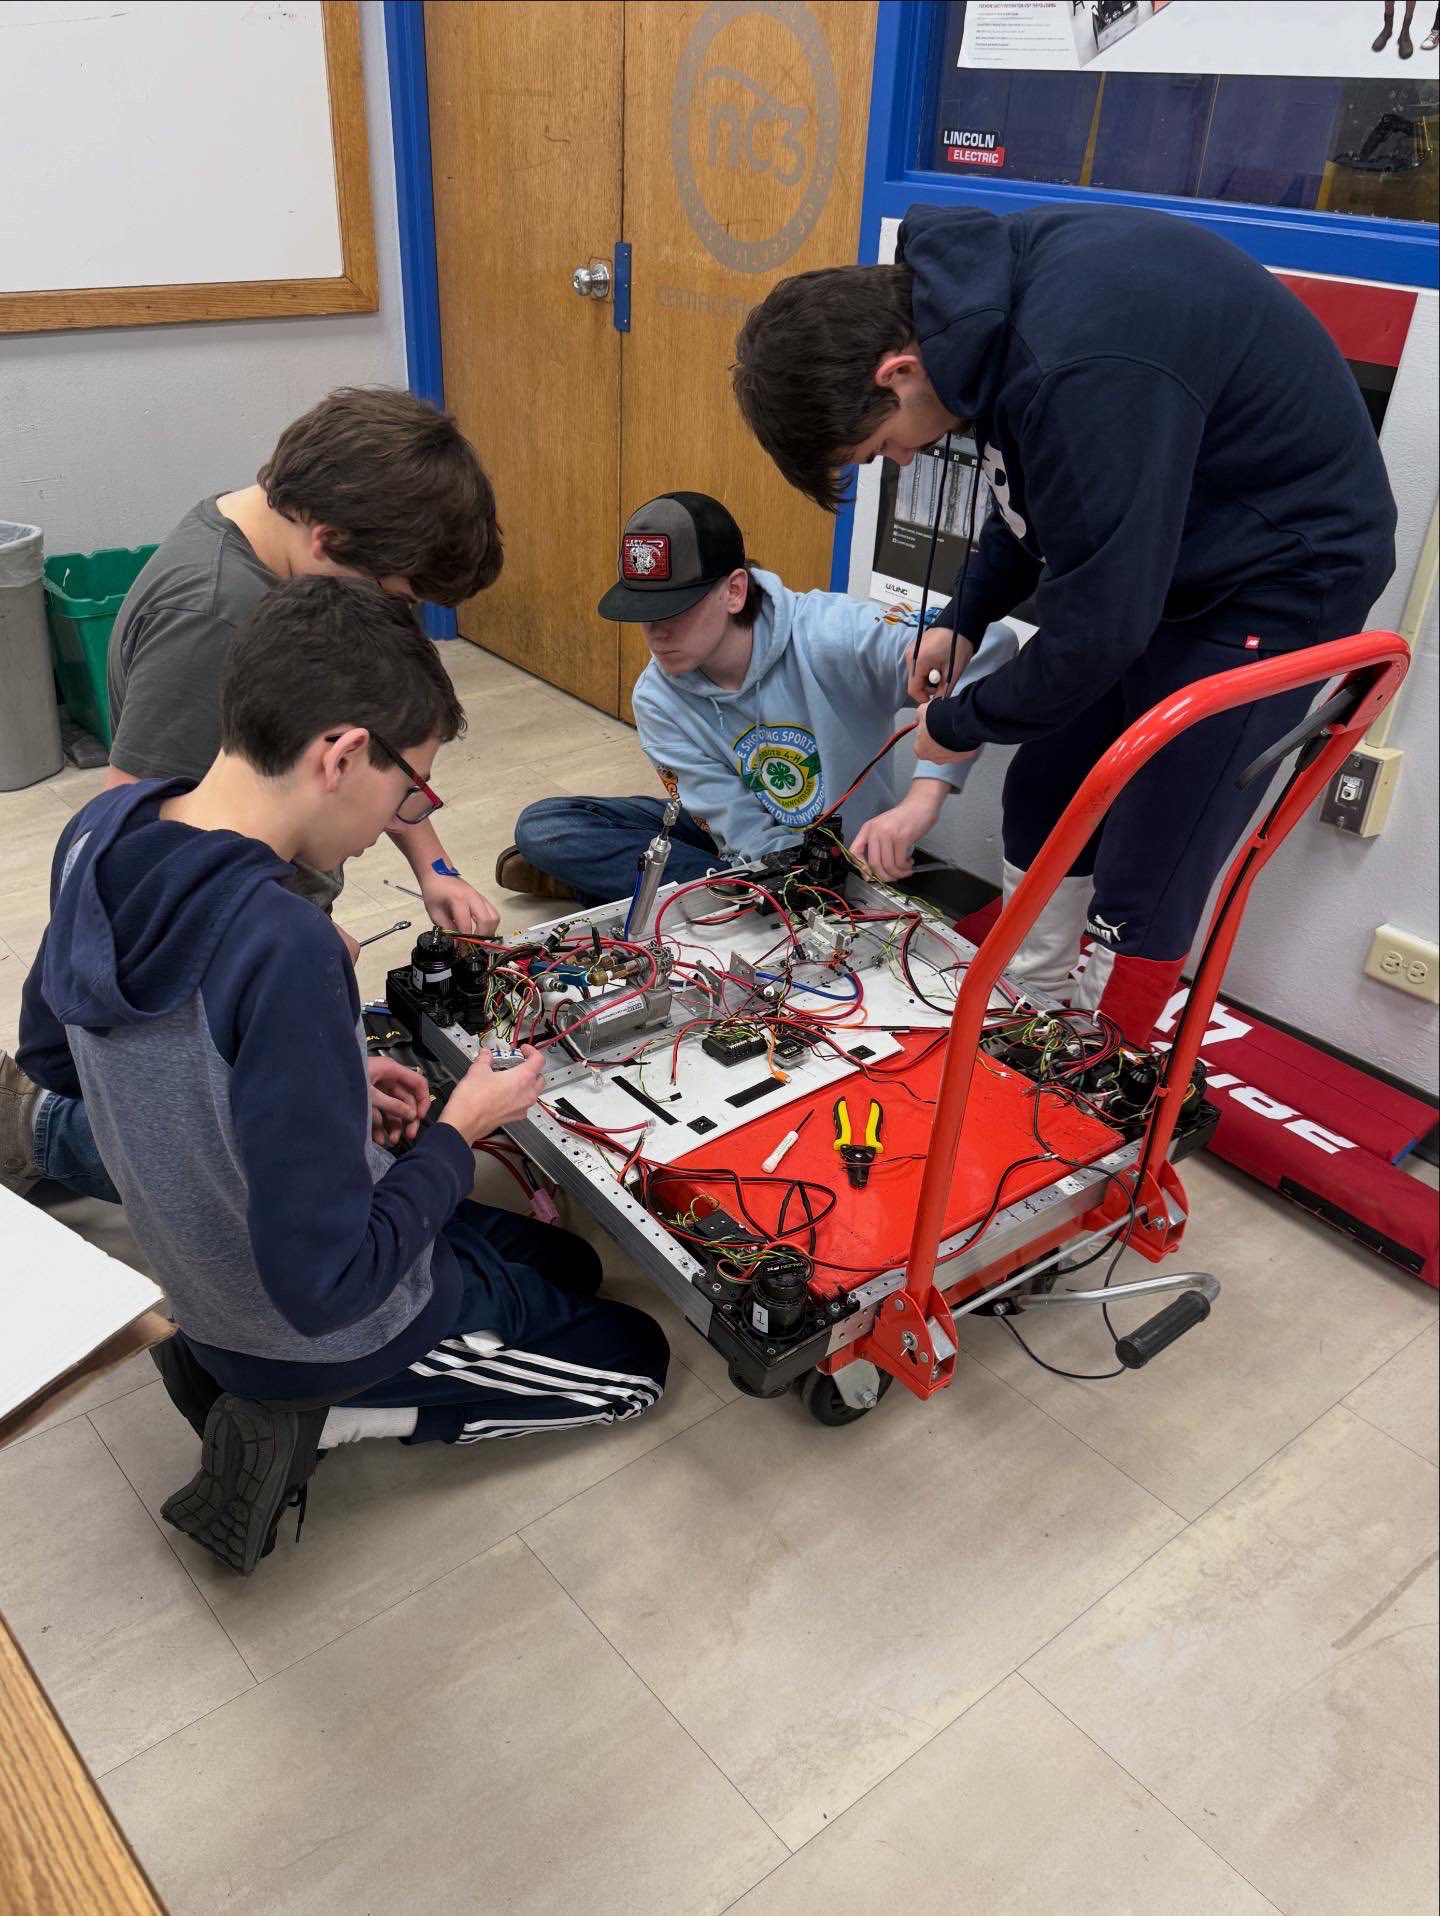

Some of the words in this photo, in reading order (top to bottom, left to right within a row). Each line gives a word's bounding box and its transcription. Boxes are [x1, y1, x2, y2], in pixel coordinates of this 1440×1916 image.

[943, 130, 995, 148] LINCOLN
[953, 149, 999, 164] ELECTRIC
[781, 730, 817, 754] SPORTS
[783, 751, 801, 764] 4-H
[756, 1311, 765, 1325] 1
